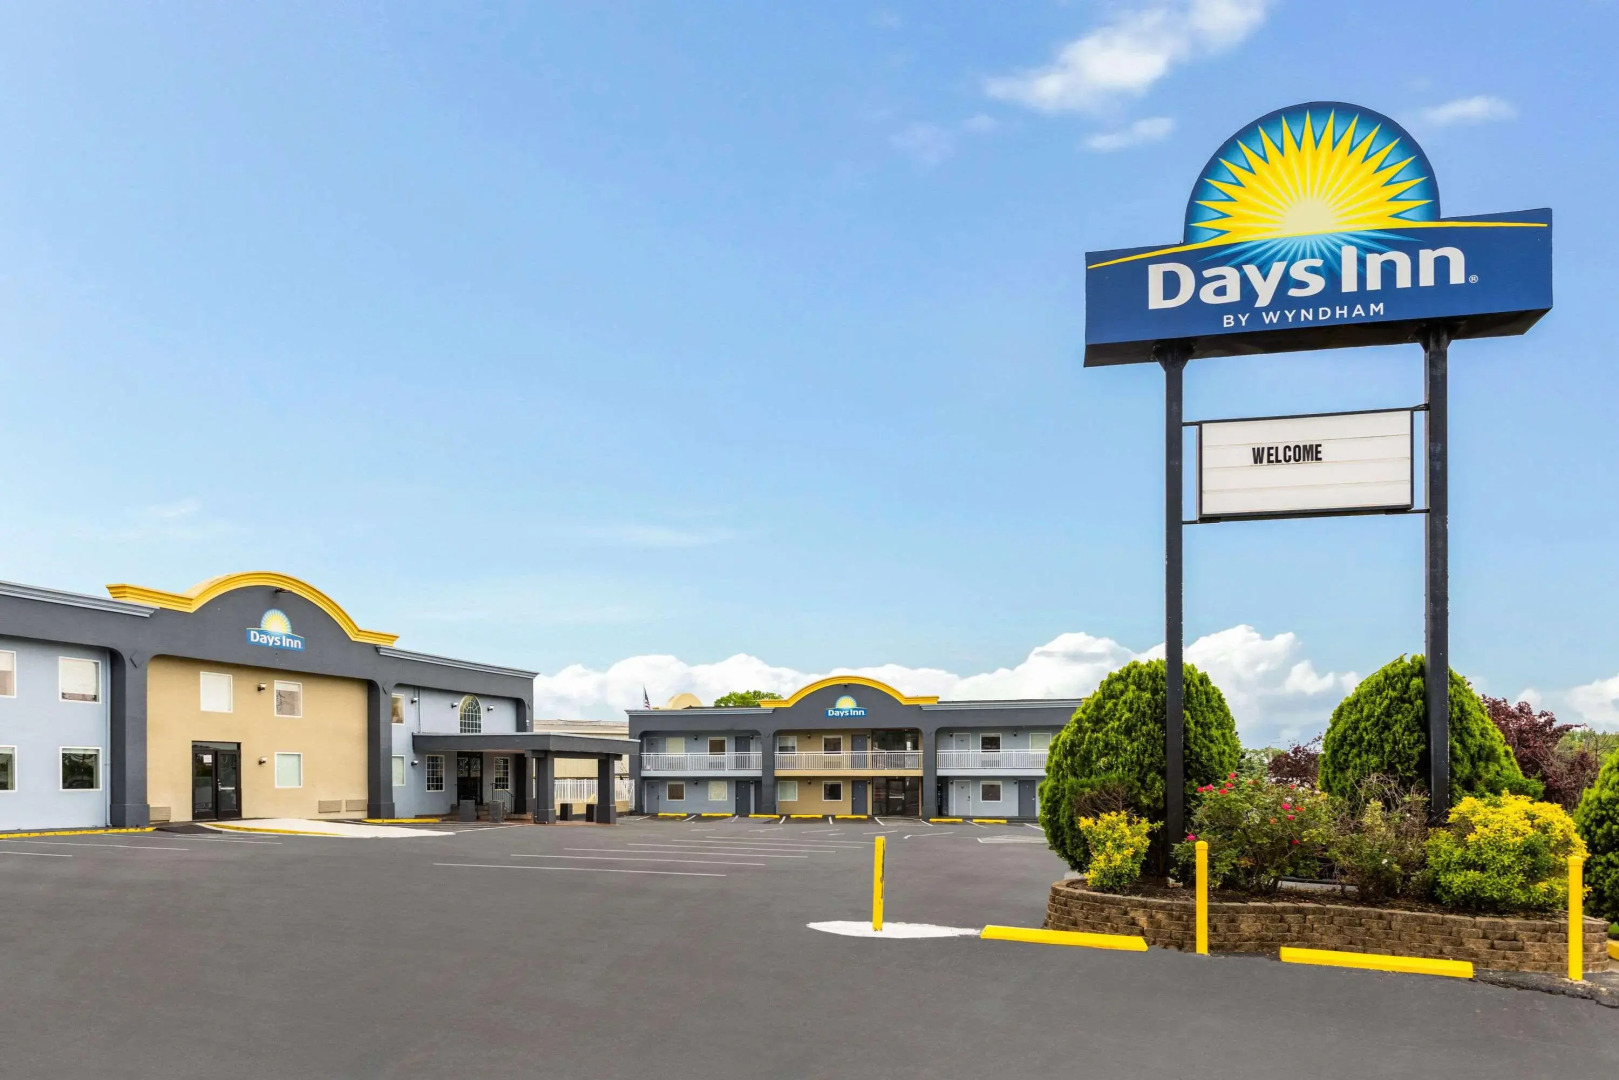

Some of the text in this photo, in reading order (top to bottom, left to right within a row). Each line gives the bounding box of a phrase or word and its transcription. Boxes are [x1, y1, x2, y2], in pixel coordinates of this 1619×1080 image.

[1147, 258, 1326, 310] Days
[1223, 302, 1385, 328] BY WYNDHAM
[1251, 443, 1323, 465] WELCOME
[250, 630, 302, 649] Days Inn
[828, 709, 850, 717] Days
